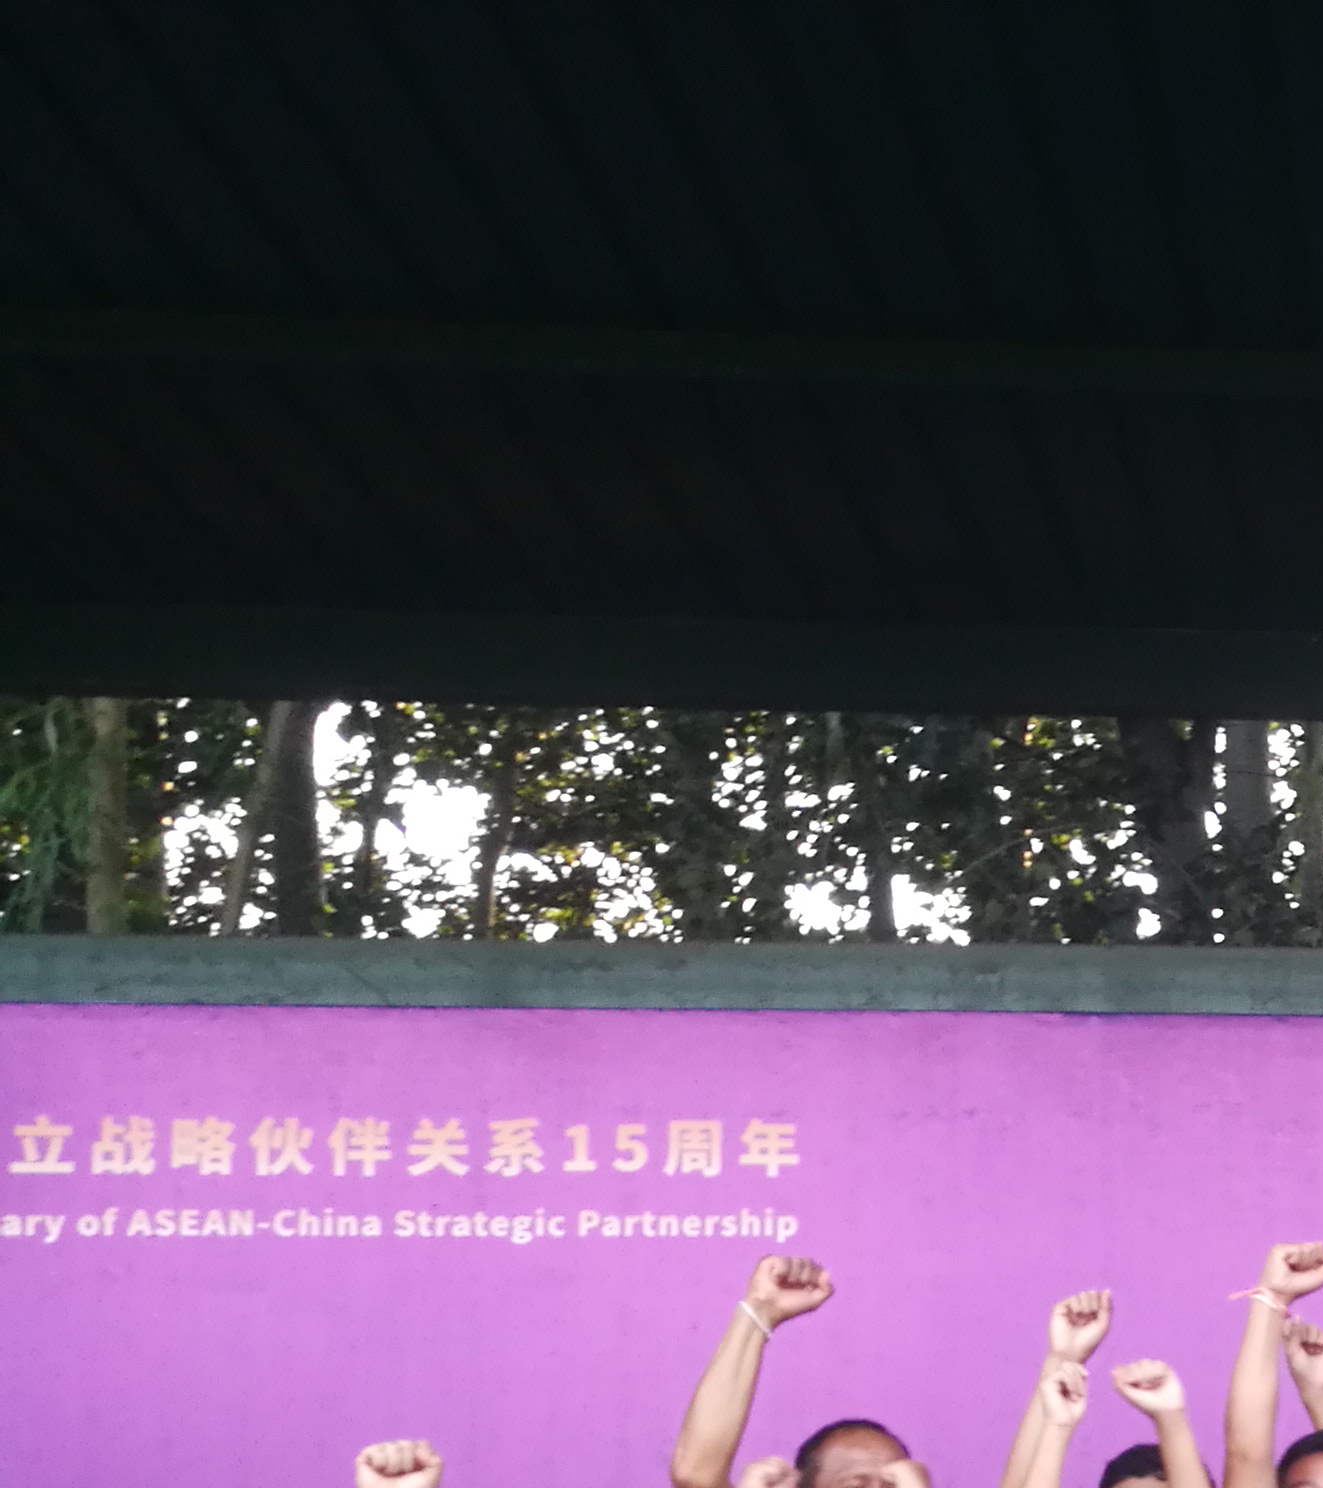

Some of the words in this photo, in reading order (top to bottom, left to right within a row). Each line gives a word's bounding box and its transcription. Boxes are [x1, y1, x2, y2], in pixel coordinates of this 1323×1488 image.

[8, 1115, 801, 1177] 立战略伙伴关系15周年
[76, 1207, 120, 1237] of
[127, 1207, 382, 1237] ASEAN-China
[393, 1208, 567, 1244] Strategic
[578, 1208, 800, 1243] Partnership
